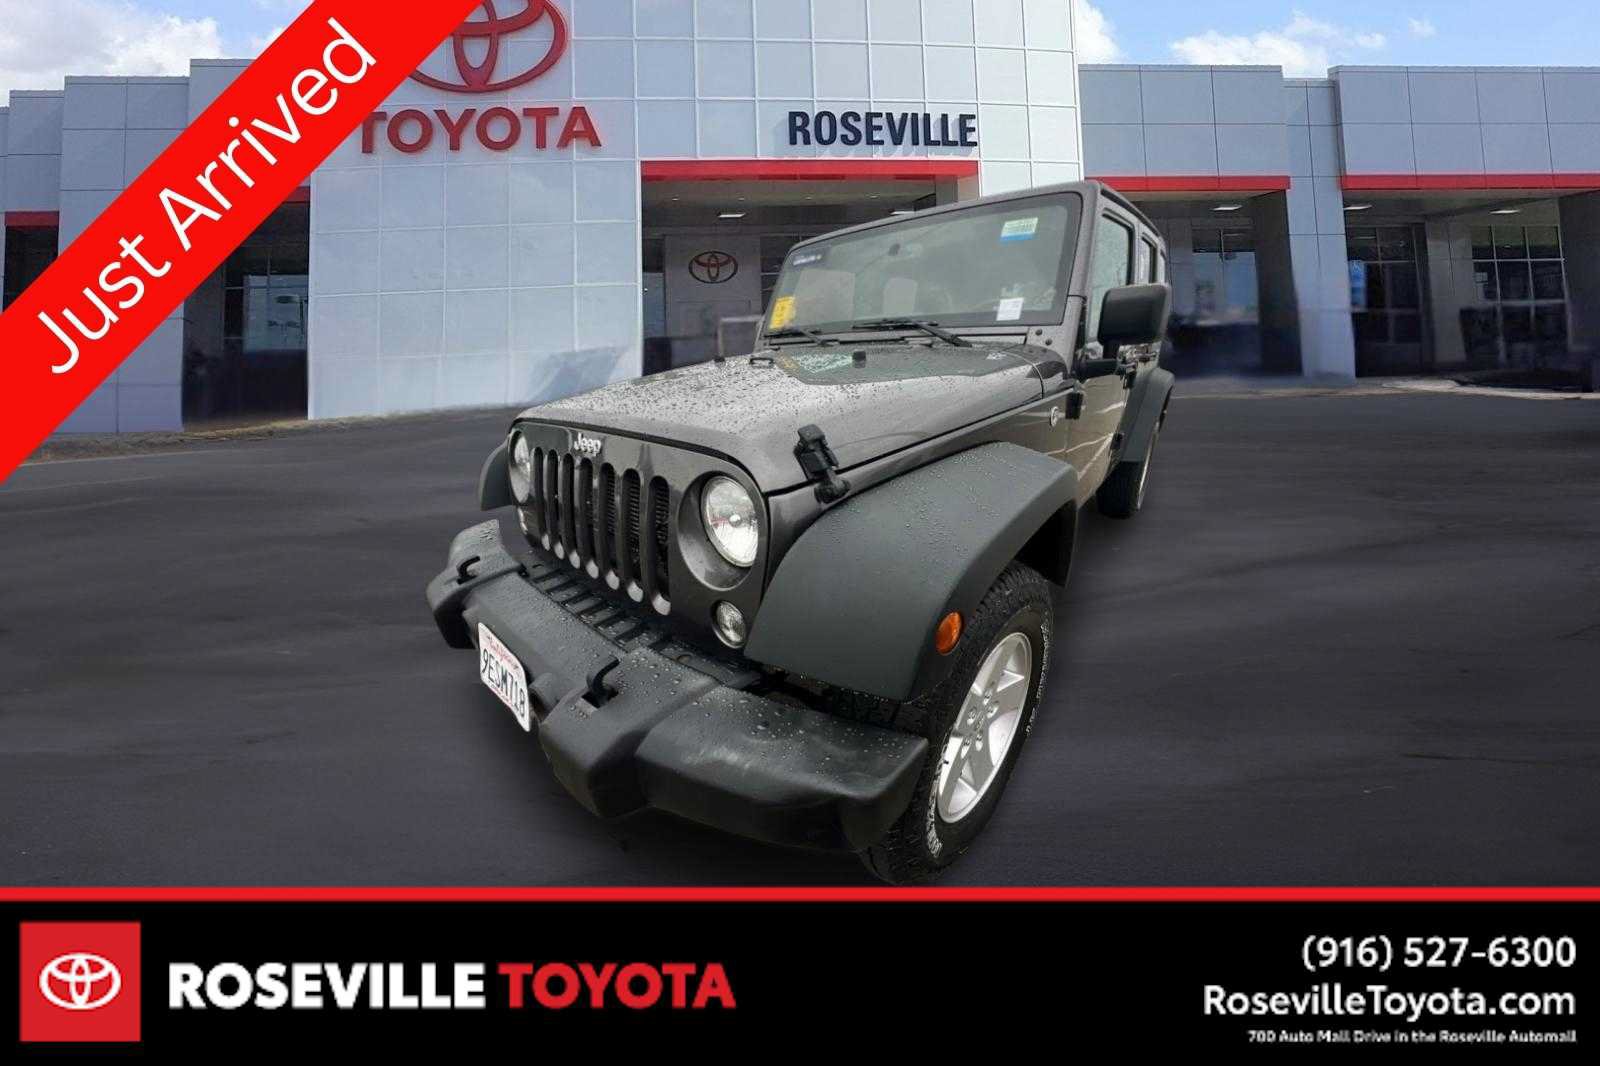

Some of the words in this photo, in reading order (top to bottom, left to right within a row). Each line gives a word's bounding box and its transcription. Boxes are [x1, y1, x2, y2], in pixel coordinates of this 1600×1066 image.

[361, 106, 602, 154] TOYOTA
[788, 110, 978, 147] ROSEVILLE
[573, 432, 602, 457] Jeep
[481, 647, 527, 718] 9ESM718
